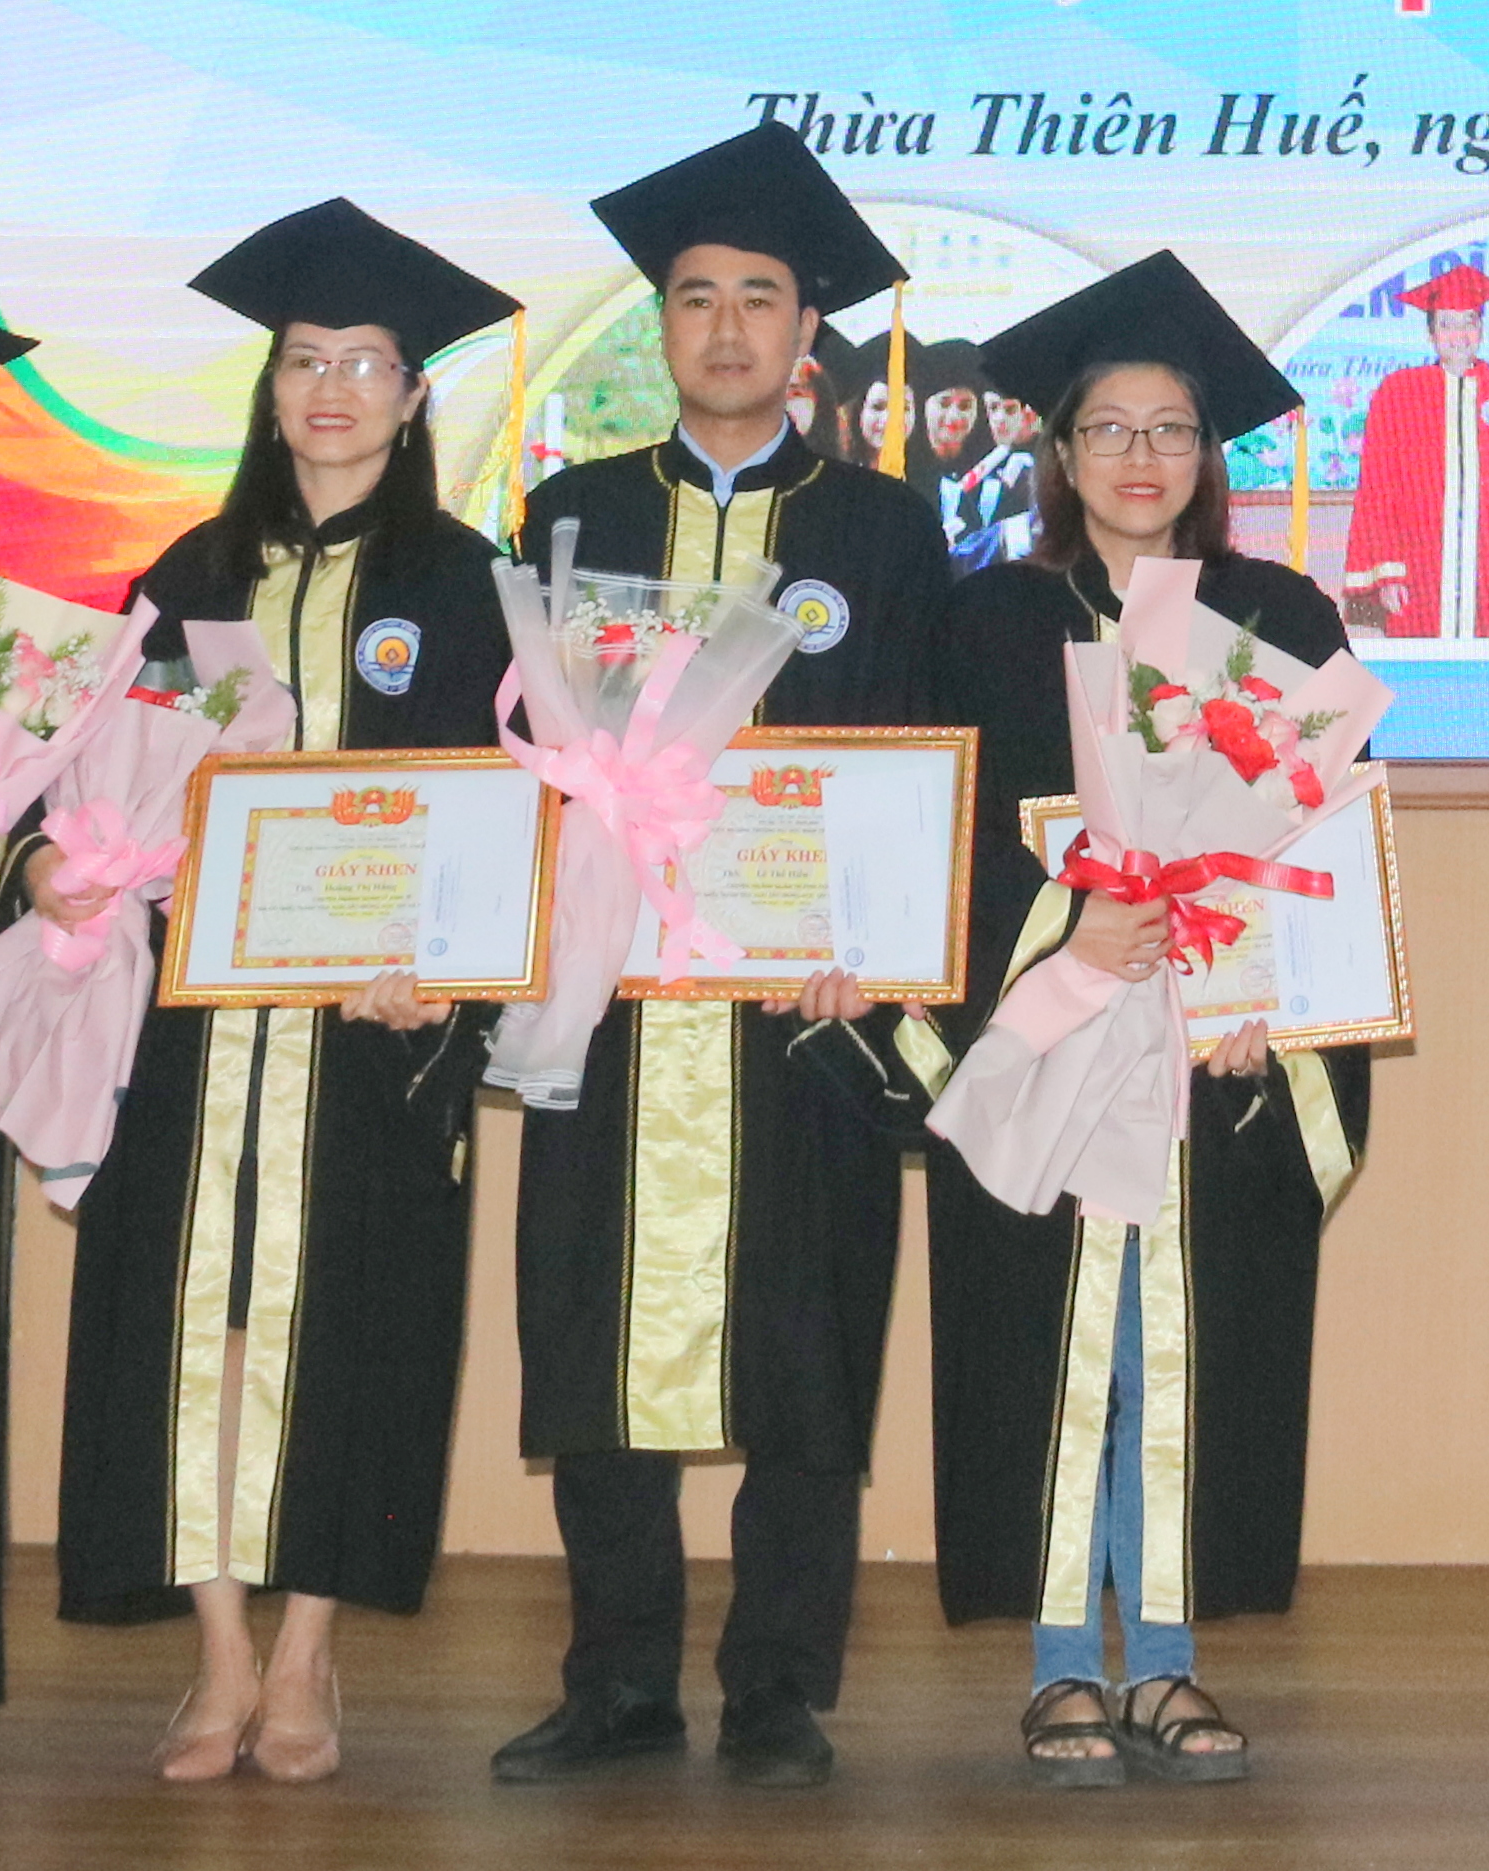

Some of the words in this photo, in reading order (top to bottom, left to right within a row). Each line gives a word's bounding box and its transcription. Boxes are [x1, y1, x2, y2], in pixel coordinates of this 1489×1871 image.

[744, 91, 937, 155] Thừa
[968, 91, 1178, 156] Thiên
[1201, 73, 1382, 168] Huế,
[737, 843, 780, 863] GIẤY
[366, 863, 418, 877] KHEN
